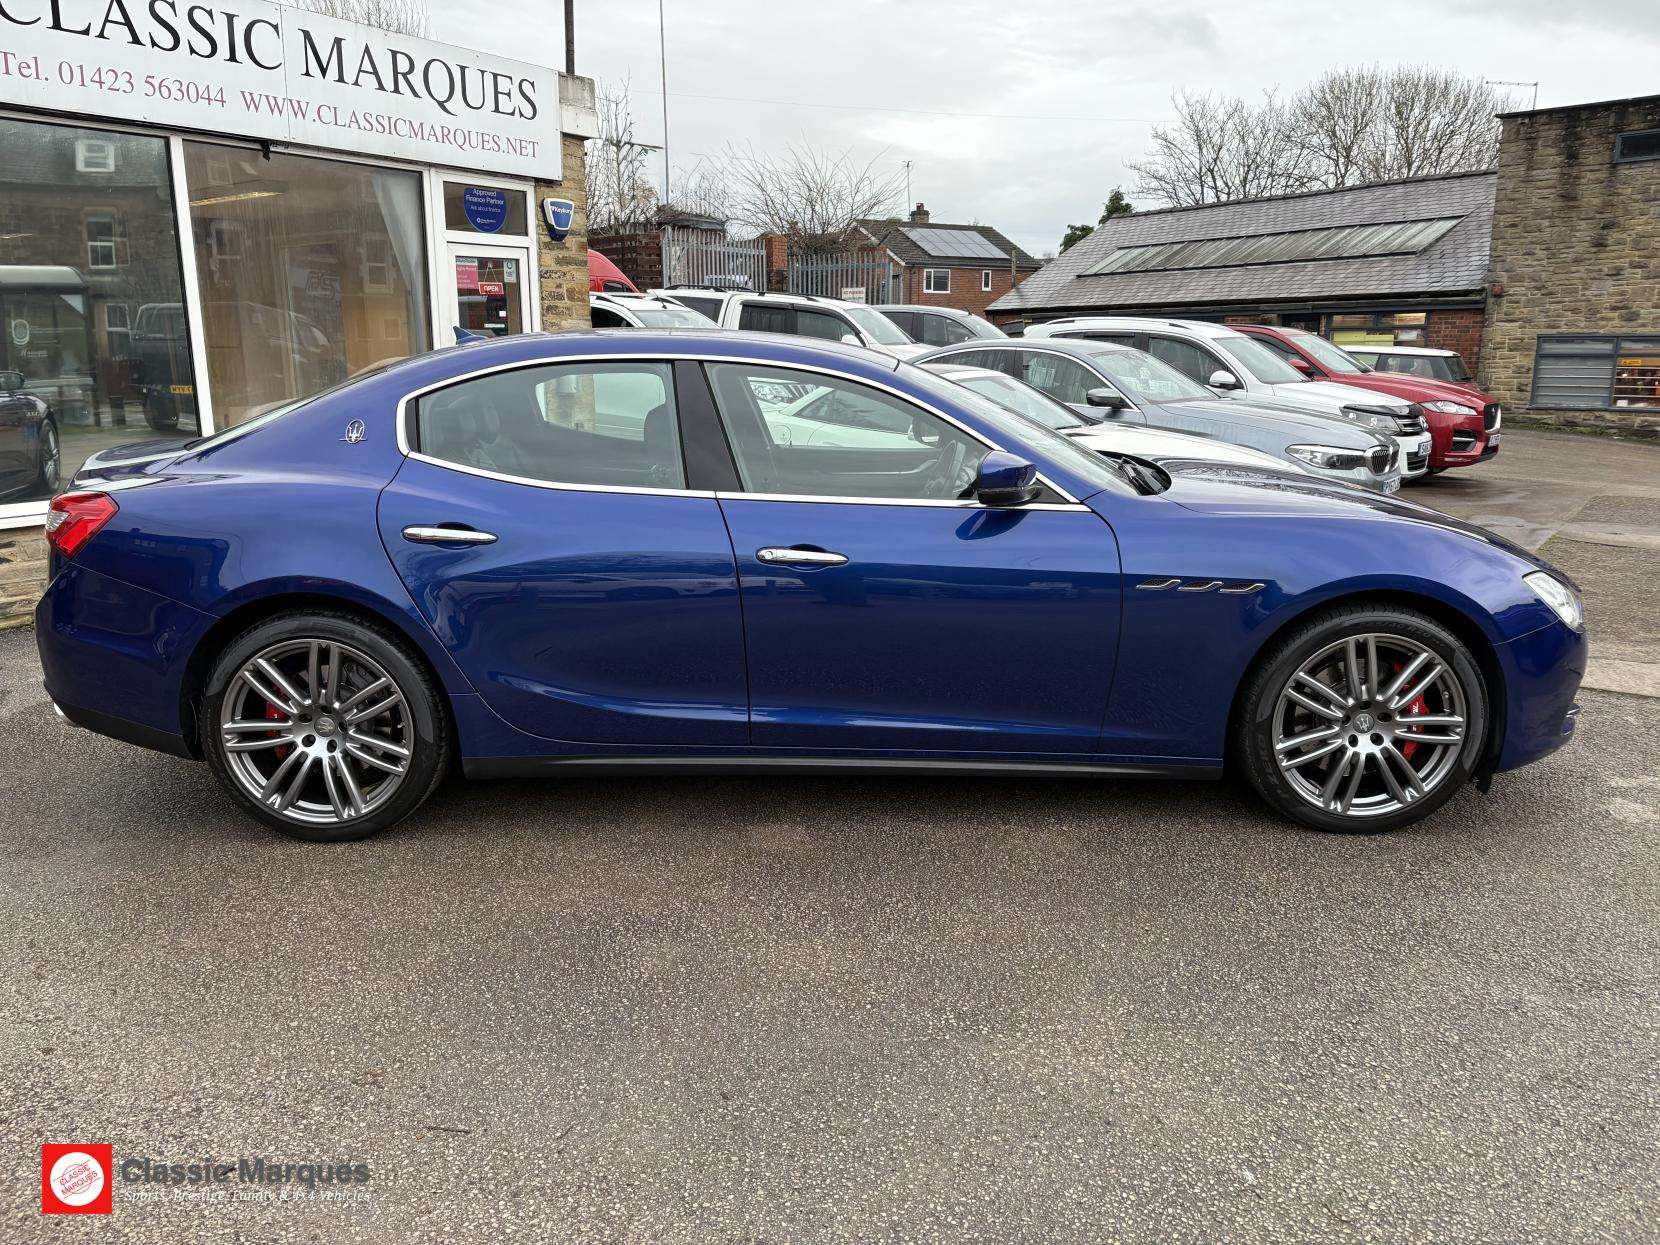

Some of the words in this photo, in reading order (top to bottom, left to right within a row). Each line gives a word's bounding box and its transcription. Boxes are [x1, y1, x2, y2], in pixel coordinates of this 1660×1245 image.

[297, 28, 538, 121] MARQUES
[0, 51, 48, 82] Tel.
[58, 60, 135, 94] 01423
[144, 75, 227, 107] 563044
[240, 90, 540, 159] WWW.CLASSICMARQUES.NET
[466, 195, 486, 203] Finance
[486, 197, 505, 206] Partner
[472, 188, 497, 198] Approved
